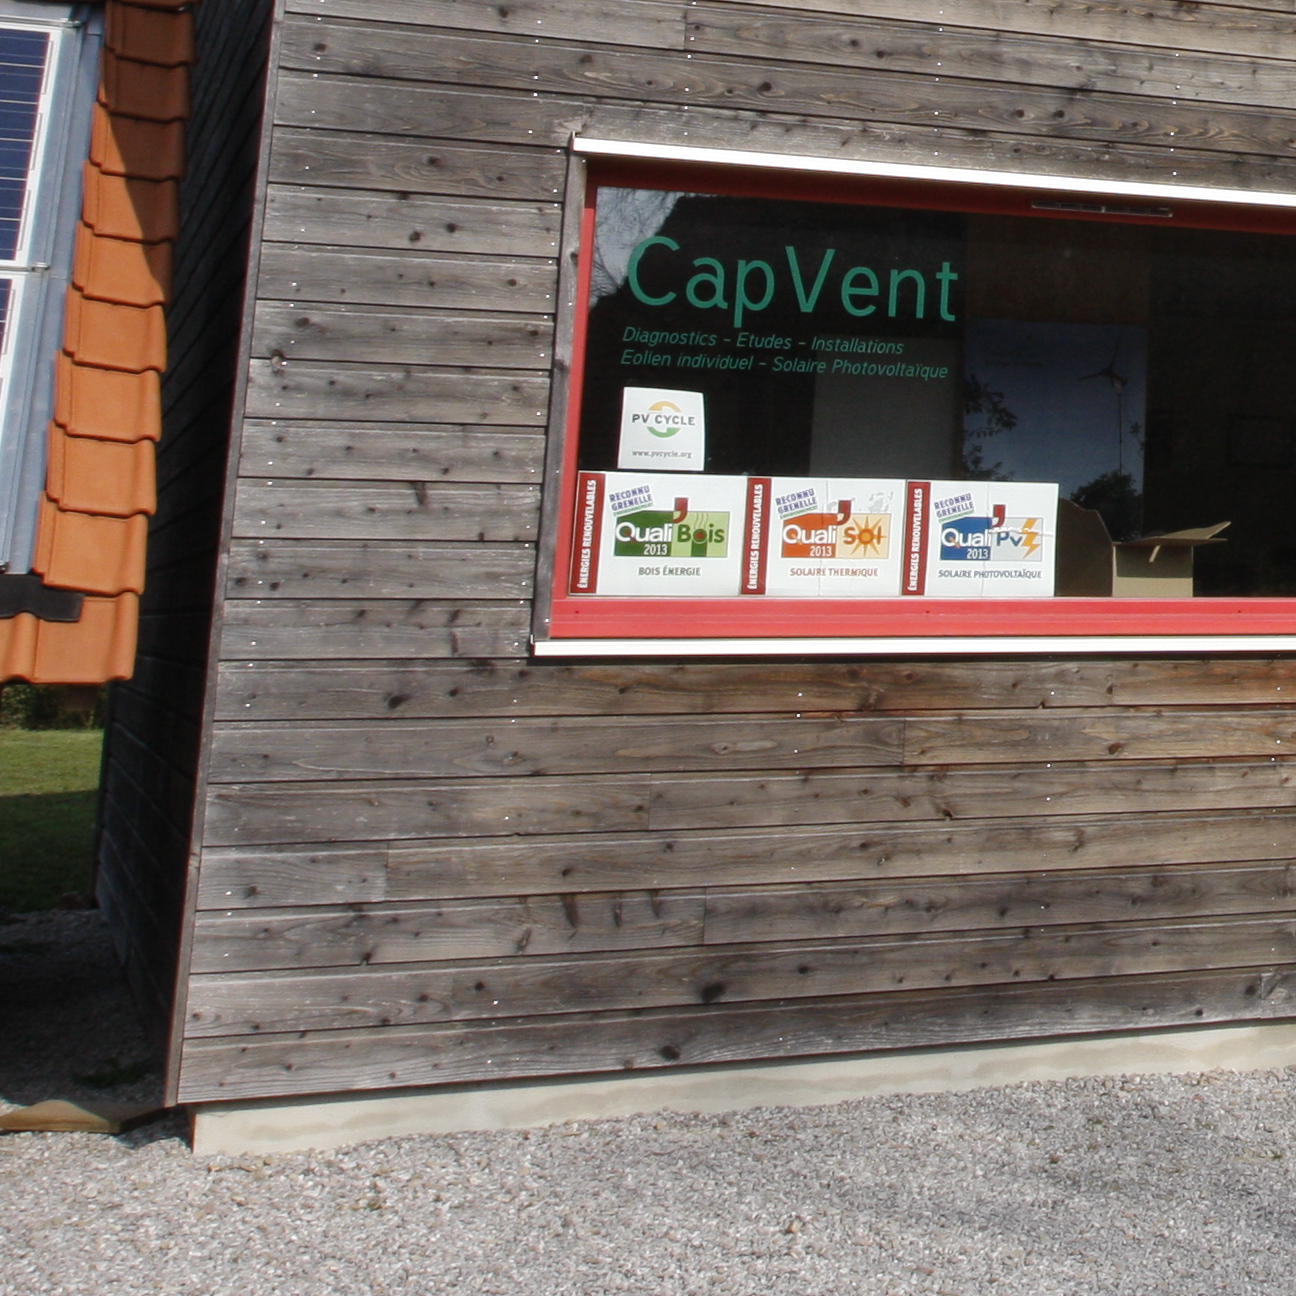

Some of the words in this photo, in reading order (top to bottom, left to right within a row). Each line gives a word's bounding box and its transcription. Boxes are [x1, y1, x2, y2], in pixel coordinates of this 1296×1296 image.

[627, 235, 959, 328] CapVent
[622, 326, 717, 347] Diagnostics
[736, 332, 792, 350] Etudes
[811, 336, 904, 355] Installations
[621, 349, 673, 366] Eolien
[677, 353, 753, 370] individuel
[772, 356, 827, 374] Solaire
[831, 360, 948, 380] Photovoltaïque
[632, 413, 651, 424] PV
[655, 414, 696, 426] CYCLE
[632, 450, 693, 460] www.pvcycle.org
[608, 485, 651, 503] RECONNU
[775, 488, 815, 506] RECONNU
[934, 493, 972, 510] RECONNU
[611, 494, 652, 512] GRENELLE
[777, 497, 817, 514] GRENELLE
[936, 502, 974, 518] GRENELLE
[583, 479, 597, 547] RENOUVELABLES
[751, 484, 763, 550] RENOUVELABLES
[911, 488, 923, 552] RENOUVELABLES
[615, 521, 673, 543] Quali
[783, 524, 837, 544] Quali
[643, 543, 668, 556] 2013
[809, 545, 833, 557] 2013
[966, 548, 989, 559] 2013
[638, 567, 660, 576] BOIS
[663, 565, 701, 576] ÉNERGIE
[790, 568, 826, 576] SOLAIRE
[829, 568, 878, 577] THERMIQUE
[938, 570, 971, 579] SOLAIRE
[973, 569, 1042, 579] PHOTOVOLTAÏQUE
